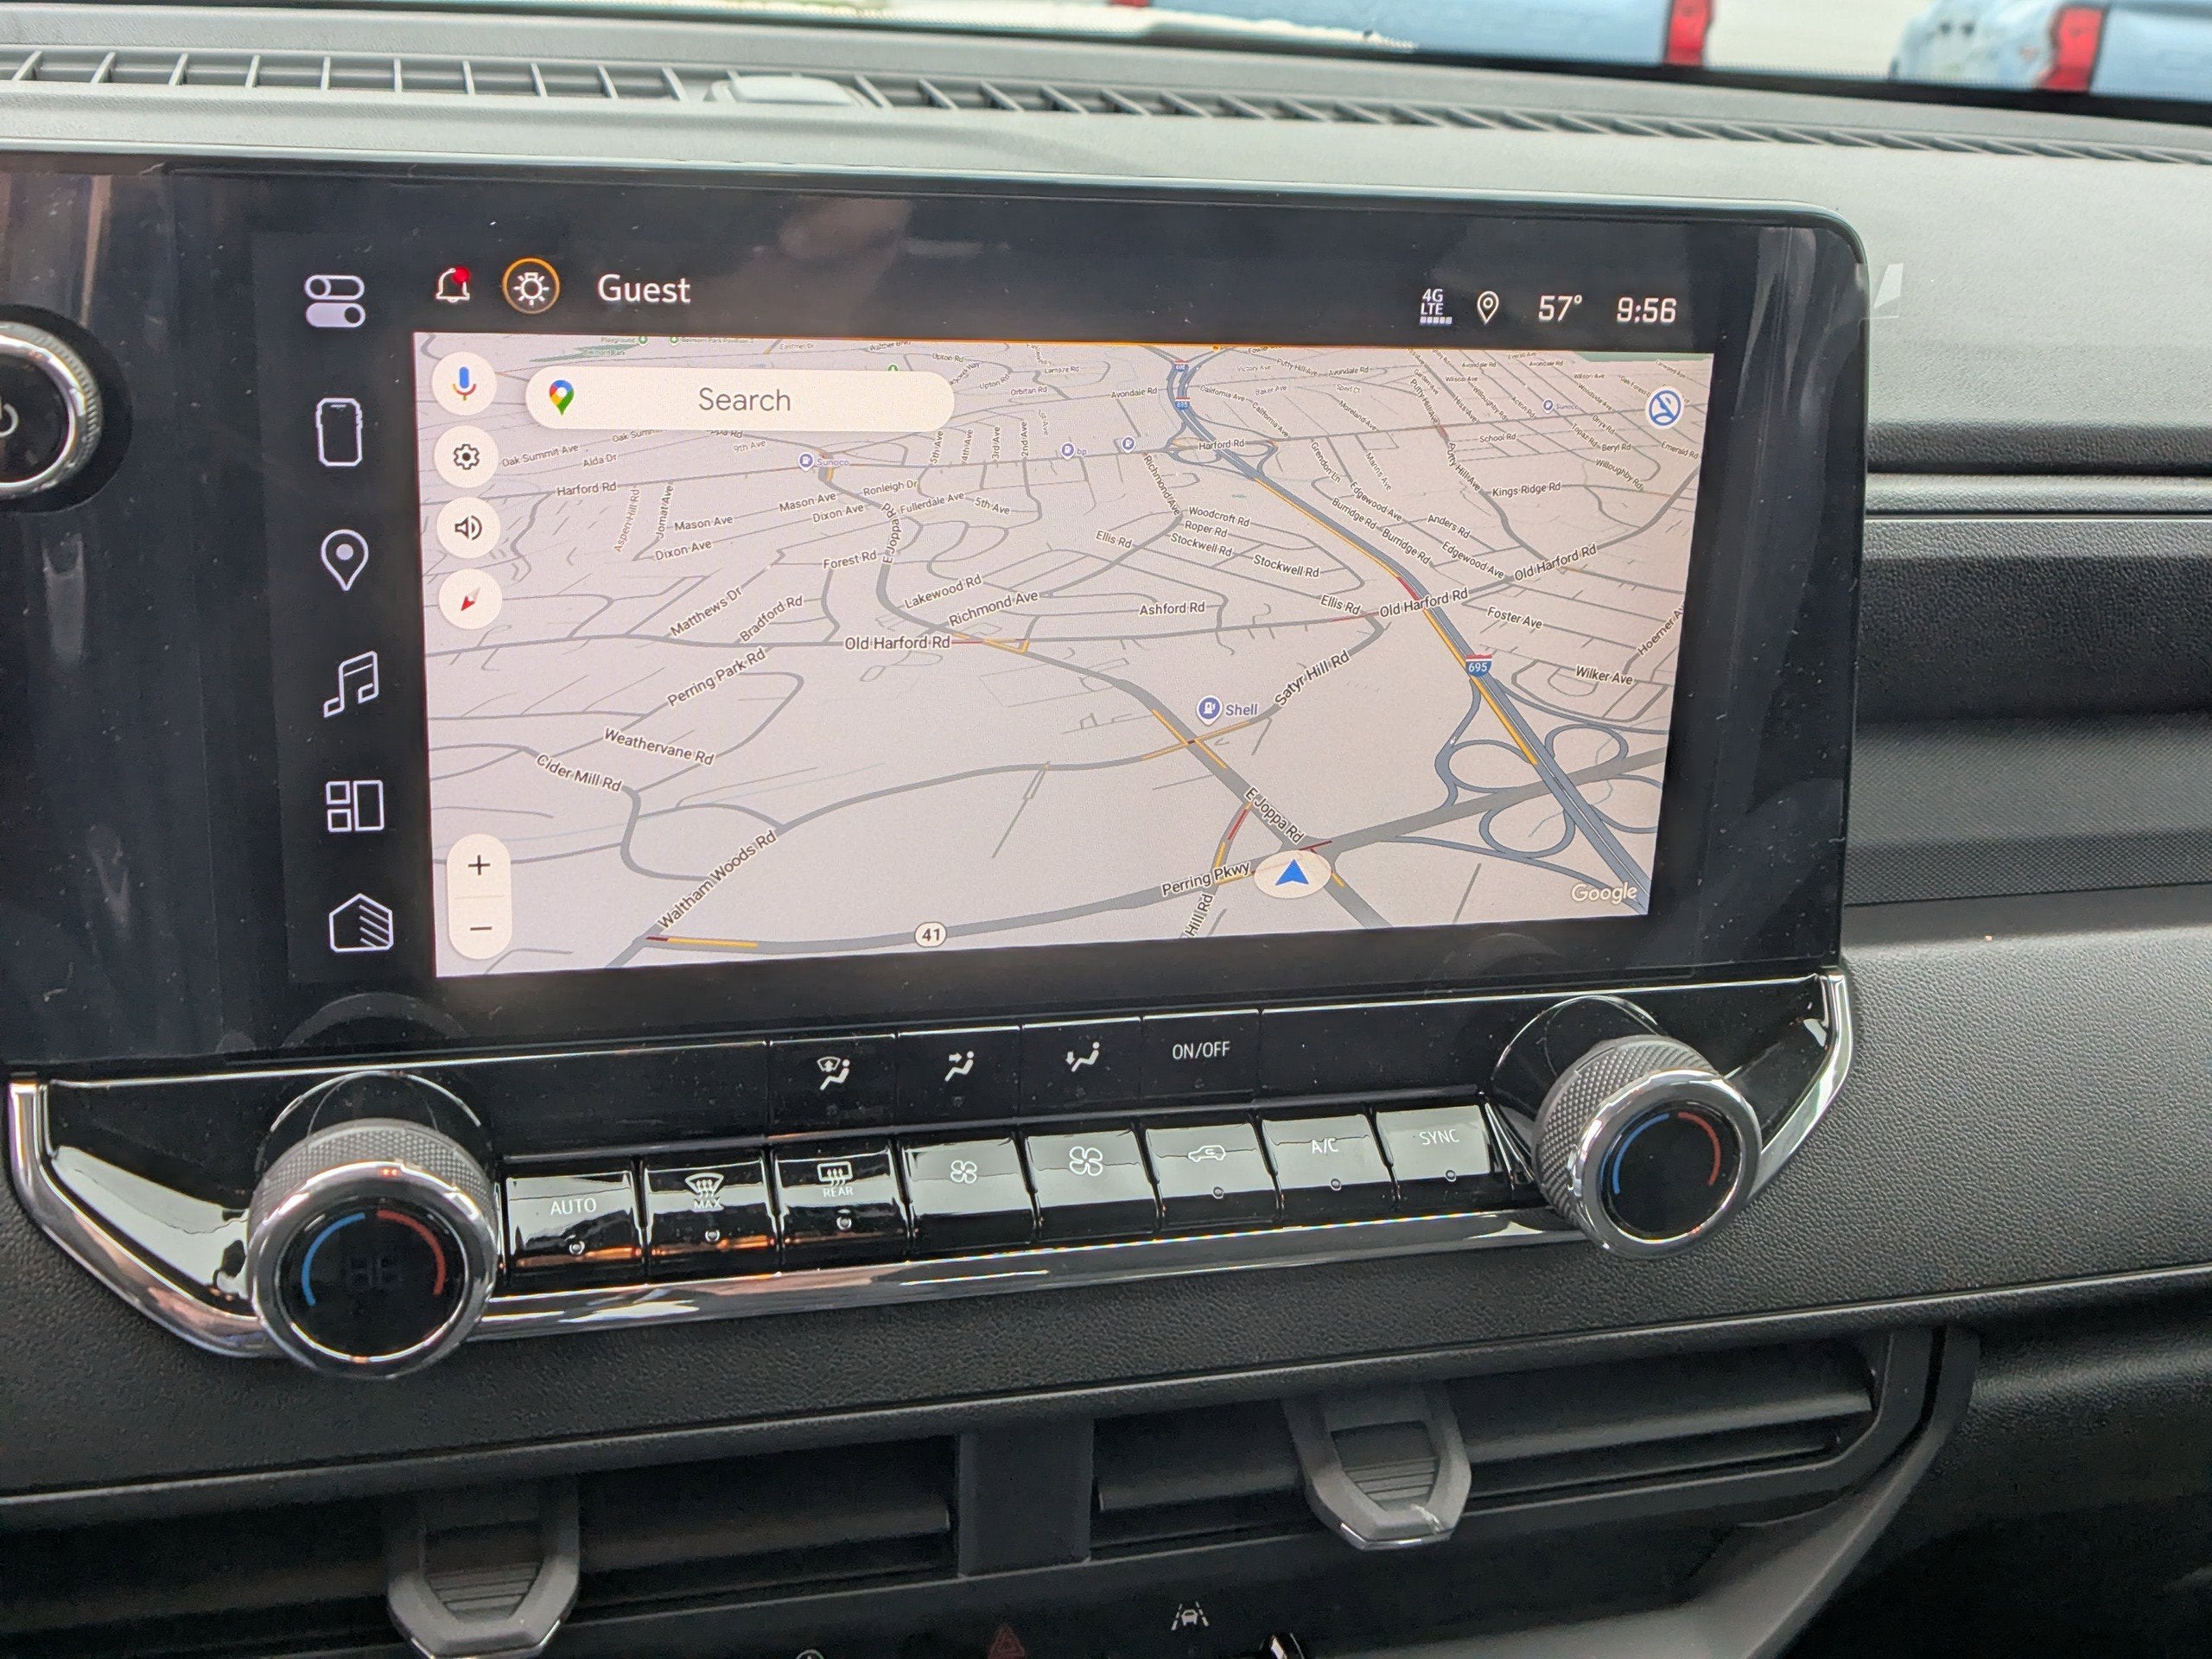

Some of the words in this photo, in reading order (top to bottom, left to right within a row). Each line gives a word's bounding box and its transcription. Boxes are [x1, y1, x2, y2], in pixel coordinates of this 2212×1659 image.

[598, 274, 690, 303] Guest
[1422, 289, 1443, 302] 4G
[1421, 302, 1443, 315] LTE
[1539, 295, 1582, 321] 57°
[1617, 297, 1676, 323] 9:56
[699, 387, 791, 411] Search
[1111, 390, 1146, 398] Avondale
[1473, 387, 1499, 413] Willoughby
[1499, 410, 1507, 420] Rd
[1339, 400, 1367, 423] Moreland
[1366, 421, 1378, 431] Ave
[1512, 397, 1527, 410] Acton
[1527, 409, 1535, 418] Rd
[1253, 403, 1277, 428] California
[1277, 425, 1288, 437] Ave
[1592, 416, 1608, 431] Onyx
[935, 431, 944, 448] Ave
[964, 429, 974, 446] Ave
[1572, 423, 1590, 442] Topaz
[503, 458, 518, 467] Oak
[522, 448, 559, 463] Summit
[562, 444, 578, 454] Ave
[962, 446, 970, 462] 4th
[1077, 448, 1087, 456] bp
[1198, 441, 1231, 450] Harford
[1601, 444, 1619, 453] Beryl
[1662, 442, 1688, 456] Emerald
[931, 448, 940, 464] 5th
[1312, 442, 1333, 475] Grendon
[1332, 473, 1341, 483] Ln
[1447, 442, 1458, 467] Putty
[1455, 462, 1468, 480] Hill
[1466, 475, 1480, 491] Ave
[1596, 459, 1633, 482] Willoughby
[1633, 478, 1643, 489] Rd
[557, 485, 597, 496] Harford
[602, 482, 617, 492] Rd
[864, 481, 903, 496] Ronleigh
[906, 480, 918, 489] Dr
[1144, 454, 1172, 498] Richmond
[1166, 498, 1181, 516] Ave
[1493, 486, 1518, 497] Kings
[1522, 485, 1546, 496] Ridge
[779, 499, 814, 512] Mason
[817, 493, 836, 503] Ave
[881, 503, 897, 518] Rd
[900, 496, 944, 513] Fullerdale
[947, 493, 964, 501] Ave
[975, 497, 989, 508] 5th
[992, 504, 1010, 514] Ave
[1350, 482, 1387, 514] Edgewood
[1388, 509, 1402, 521] Ave
[675, 519, 709, 531] Mason
[714, 516, 733, 525] Ave
[813, 508, 842, 523] Dixon
[846, 504, 863, 513] Ave
[1189, 506, 1235, 523] Woodcroft
[1237, 517, 1250, 526] Rd
[1332, 499, 1364, 524] Burridge
[1364, 518, 1376, 529] Rd
[887, 518, 899, 554] Joppa
[1185, 521, 1212, 534] Roper
[1215, 527, 1228, 537] Rd
[1427, 515, 1457, 533] Anders
[1458, 527, 1471, 537] Rd
[1096, 531, 1115, 543] Ellis
[1118, 536, 1132, 548] Rd
[1171, 534, 1217, 552] Stockwell
[1220, 545, 1232, 556] Rd
[1382, 529, 1419, 558] Burridge
[1417, 552, 1430, 563] Rd
[656, 544, 688, 561] Dixon
[691, 540, 711, 550] Ave
[823, 553, 859, 568] Forest
[861, 550, 877, 561] Rd
[1441, 542, 1486, 570] Edgewood
[1488, 565, 1503, 578] Ave
[1254, 555, 1303, 575] Stockwell
[1306, 567, 1319, 577] Rd
[1516, 568, 1534, 581] Old
[1536, 551, 1579, 575] Harford
[1581, 543, 1597, 556] Rd
[905, 582, 963, 609] Lakewood
[966, 575, 982, 588] Rd
[671, 598, 728, 637] Matthews
[727, 587, 743, 601] Dr
[949, 599, 1012, 626] Richmond
[1015, 592, 1039, 605] Ave
[1140, 603, 1186, 615] Ashford
[1190, 601, 1205, 612] Rd
[1321, 595, 1343, 609] Ellis
[1345, 601, 1361, 614] Rd
[1380, 606, 1400, 617] Old
[1405, 593, 1450, 613] Harford
[1452, 588, 1468, 601] Rd
[740, 603, 785, 642] Bradford
[786, 596, 803, 607] Rd
[1487, 607, 1521, 623] Foster
[1523, 618, 1541, 629] Ave
[845, 637, 868, 650] Old
[874, 637, 929, 649] Harford
[932, 637, 950, 648] Rd
[1469, 663, 1487, 671] 695
[1576, 666, 1610, 681] Wilker
[1612, 672, 1633, 684] Ave
[668, 677, 715, 707] Perring
[715, 660, 746, 682] Park
[747, 648, 766, 664] Rd
[1275, 675, 1306, 706] Satyr
[1306, 661, 1329, 682] Hill
[1331, 651, 1350, 668] Rd
[1226, 704, 1258, 716] Shell
[605, 728, 692, 760] Weathervane
[696, 752, 714, 766] Rd
[537, 755, 572, 777] Cider
[575, 770, 600, 786] Mill
[602, 778, 621, 791] Rd
[1245, 787, 1257, 800] E
[1255, 797, 1288, 829] Joppa
[1287, 827, 1304, 843] Rd
[658, 880, 712, 929] Waltham
[710, 846, 755, 882] Woods
[755, 830, 777, 849] Rd
[1162, 874, 1211, 895] Perring
[1214, 862, 1250, 880] Pkwy
[1572, 883, 1637, 904] Google
[1185, 911, 1205, 937] Hill
[1198, 894, 1212, 912] Rd
[923, 928, 941, 940] 41
[1173, 1041, 1230, 1059] ON/OFF
[1312, 1139, 1338, 1154] A/C
[1419, 1130, 1459, 1145] SYNC
[823, 1186, 854, 1197] REAR
[550, 1198, 596, 1216] AUTO
